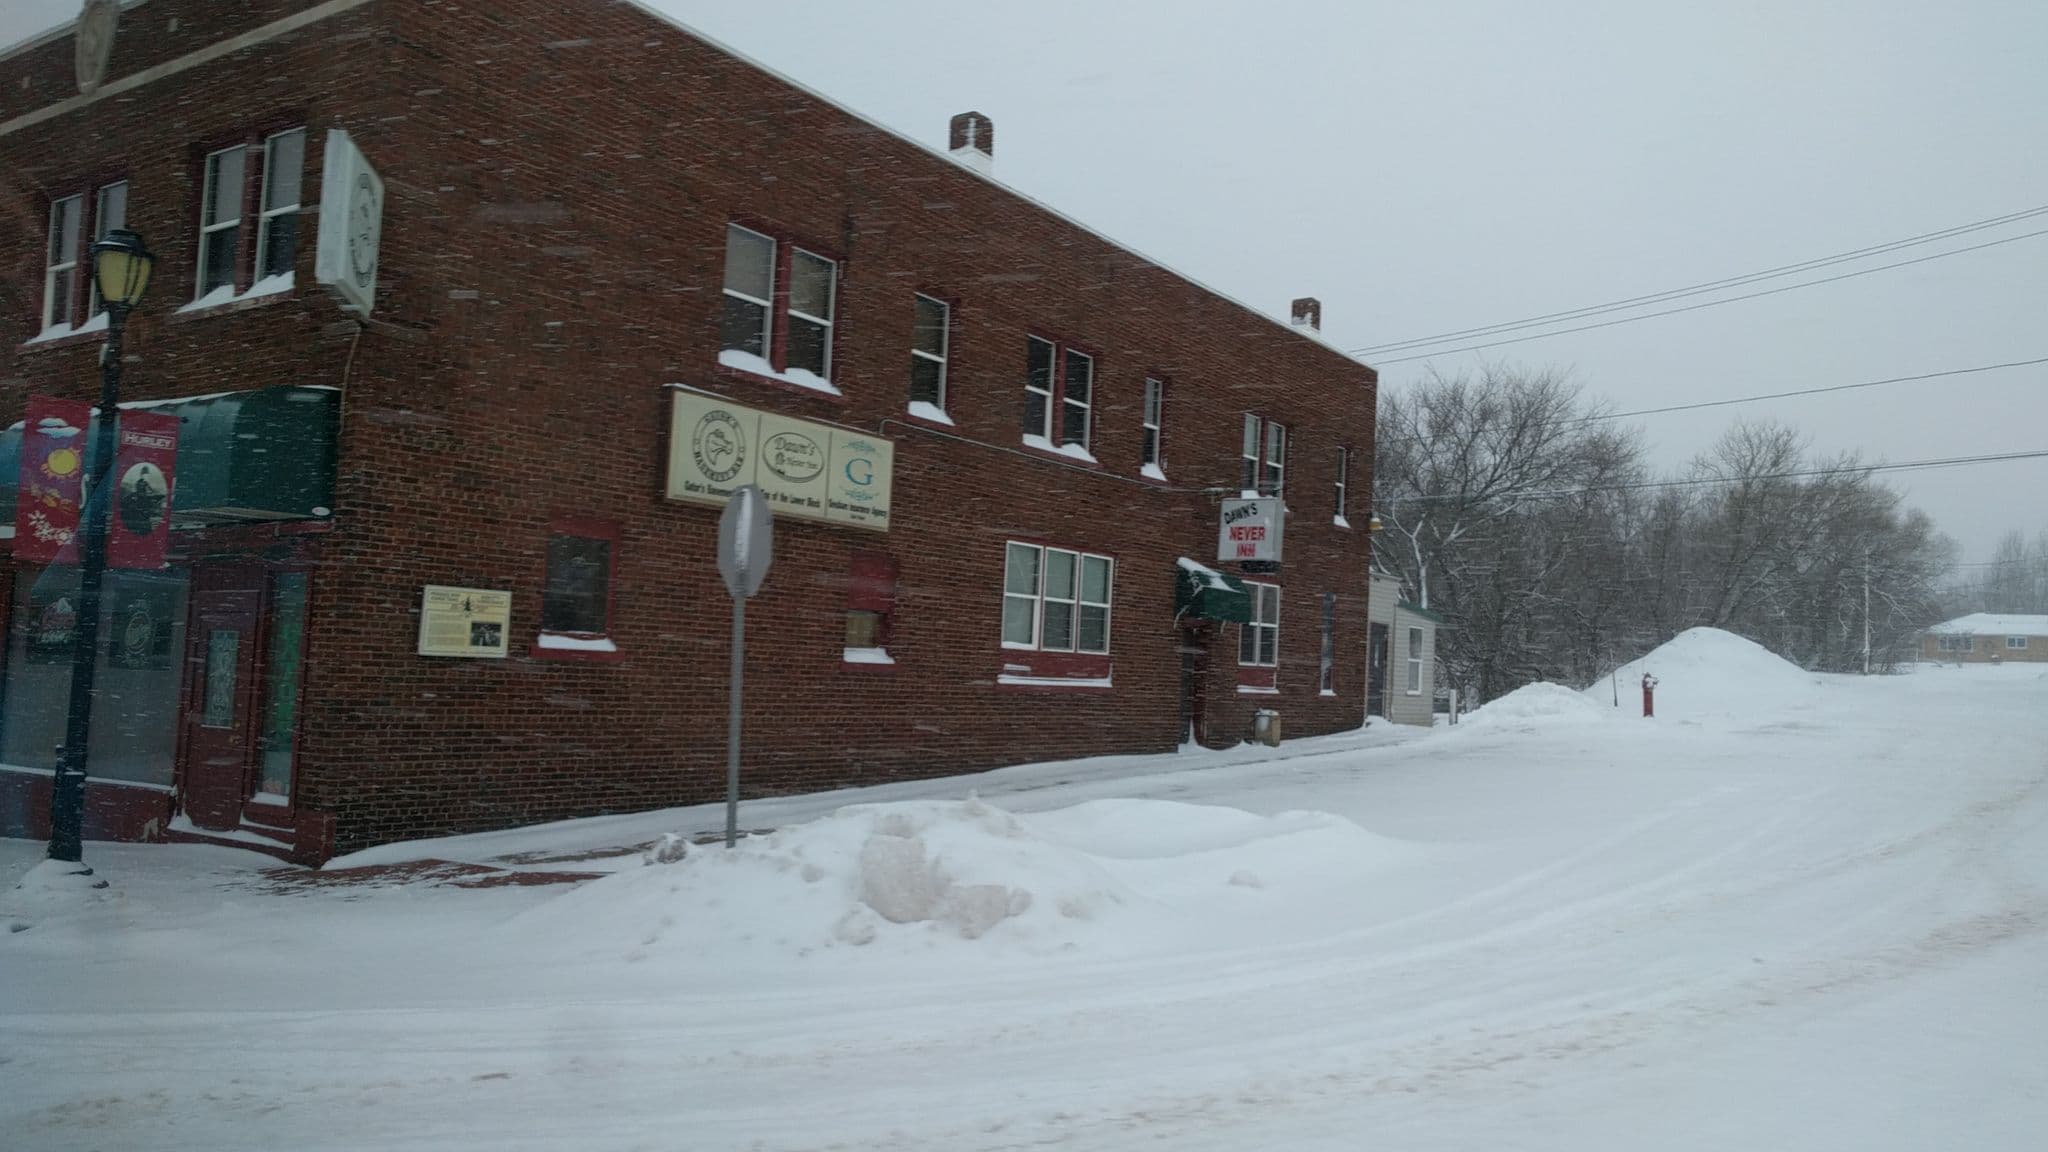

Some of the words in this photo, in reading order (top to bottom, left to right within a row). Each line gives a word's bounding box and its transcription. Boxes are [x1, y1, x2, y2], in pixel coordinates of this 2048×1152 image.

[122, 432, 174, 449] HURLEY
[845, 458, 873, 486] G
[1229, 526, 1265, 541] NEVER
[1237, 543, 1256, 557] INN
